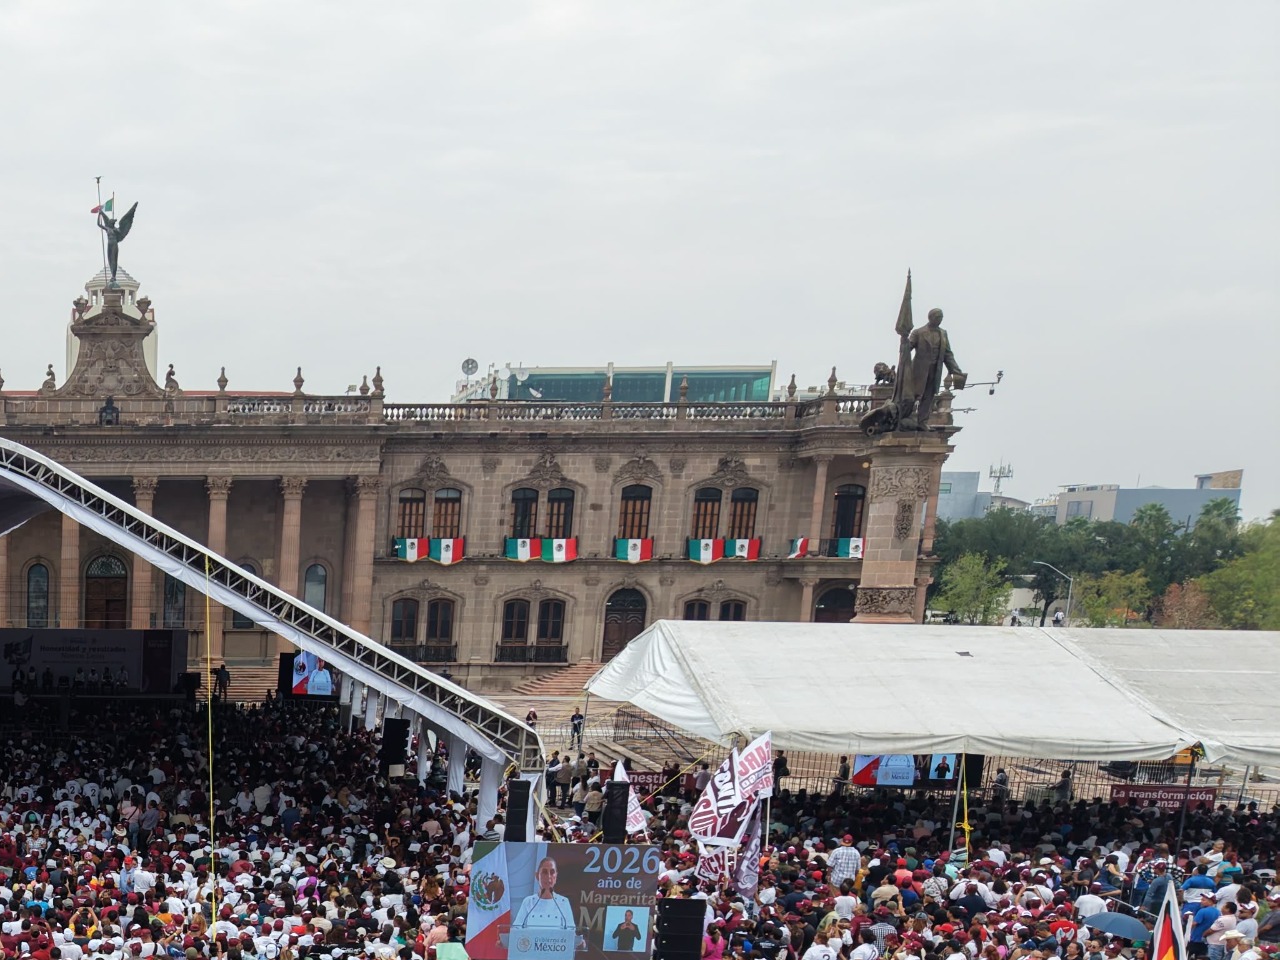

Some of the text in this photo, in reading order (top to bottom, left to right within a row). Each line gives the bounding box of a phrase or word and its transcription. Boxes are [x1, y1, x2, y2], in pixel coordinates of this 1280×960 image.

[1112, 789, 1213, 801] La transformción
[1143, 800, 1180, 808] aanza
[583, 846, 660, 874] 2026
[597, 876, 642, 889] año de
[580, 889, 657, 906] Margarita
[534, 942, 566, 952] México
